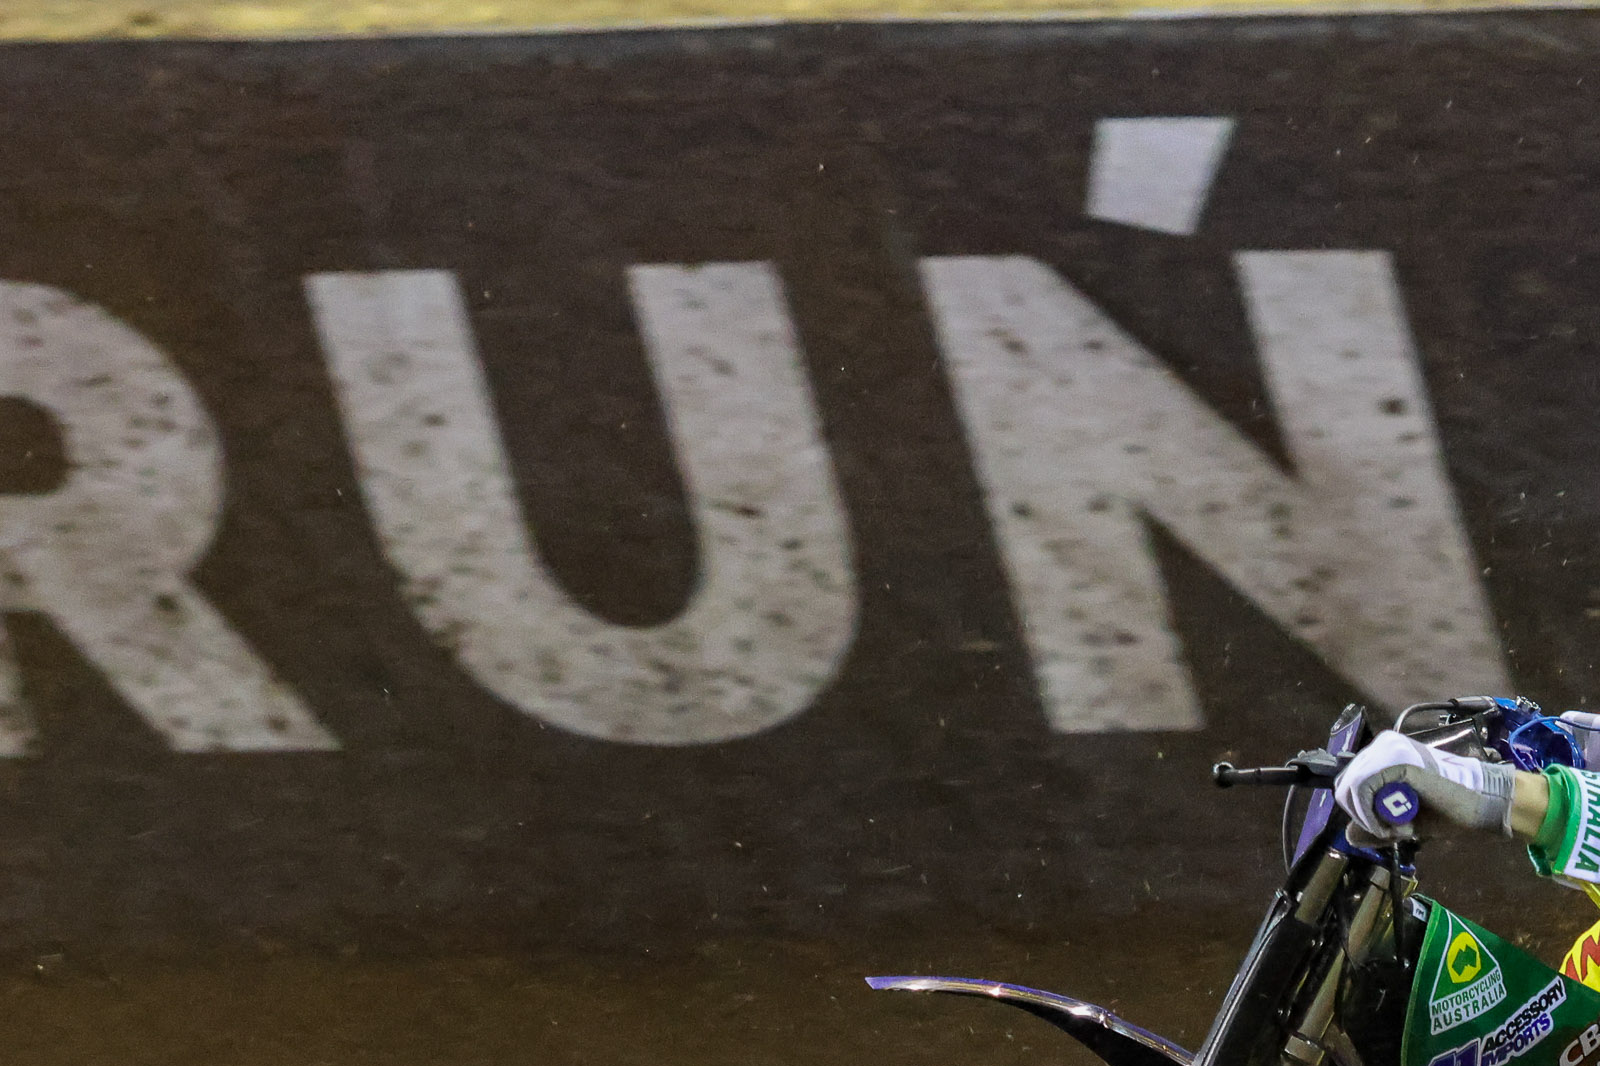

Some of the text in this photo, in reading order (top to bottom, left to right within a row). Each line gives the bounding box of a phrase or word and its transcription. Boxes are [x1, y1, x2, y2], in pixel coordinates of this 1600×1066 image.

[1431, 968, 1502, 1017] MOTORCYCLING
[1431, 983, 1506, 1032] AUSTRALIA
[1482, 981, 1565, 1054] ACCESSORY
